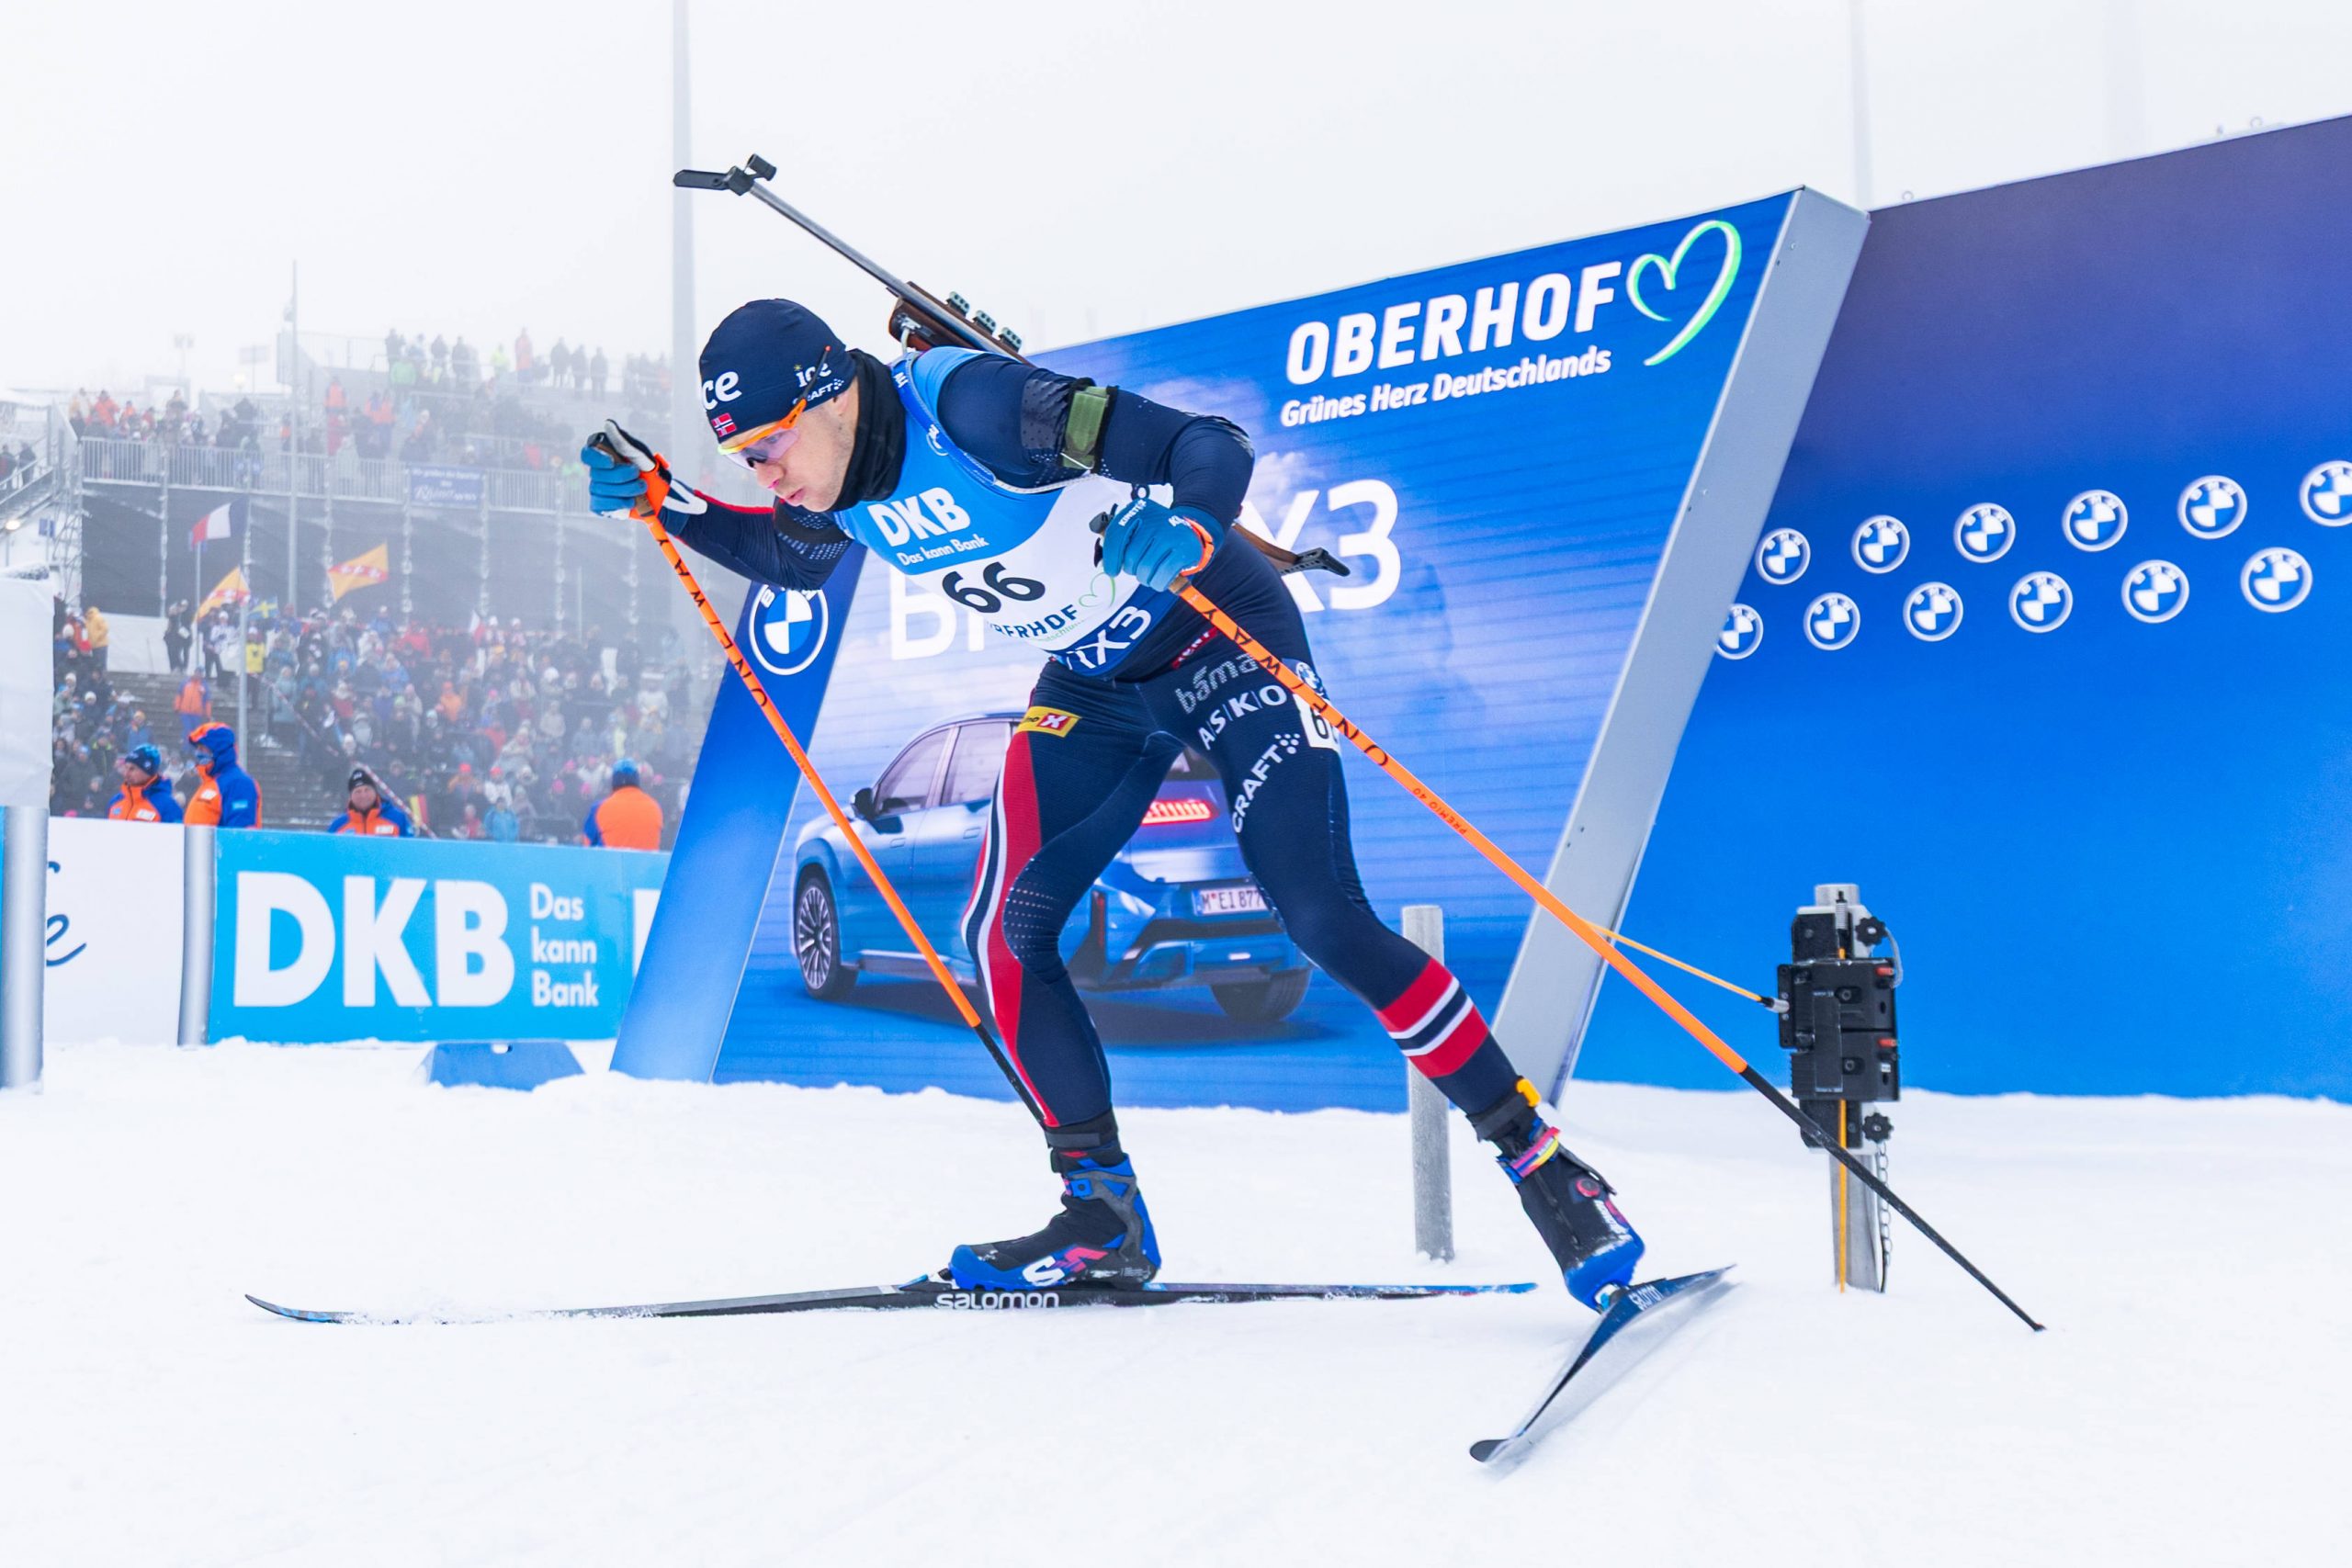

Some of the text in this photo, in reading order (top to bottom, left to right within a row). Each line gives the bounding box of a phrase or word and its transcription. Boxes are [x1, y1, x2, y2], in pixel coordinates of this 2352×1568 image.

[1286, 261, 1622, 385] OBERHOF
[701, 370, 742, 411] ce
[1281, 344, 1612, 427] Grünes Herz Deutschlands
[867, 487, 971, 547] DKB
[897, 534, 989, 566] Das kann Bank
[1232, 479, 1401, 614] X3
[942, 562, 1046, 614] 66
[1231, 744, 1283, 833] CRAFT
[530, 882, 584, 921] Das
[233, 871, 515, 1008] DKB
[531, 925, 597, 964] kann
[531, 969, 600, 1008] Bank
